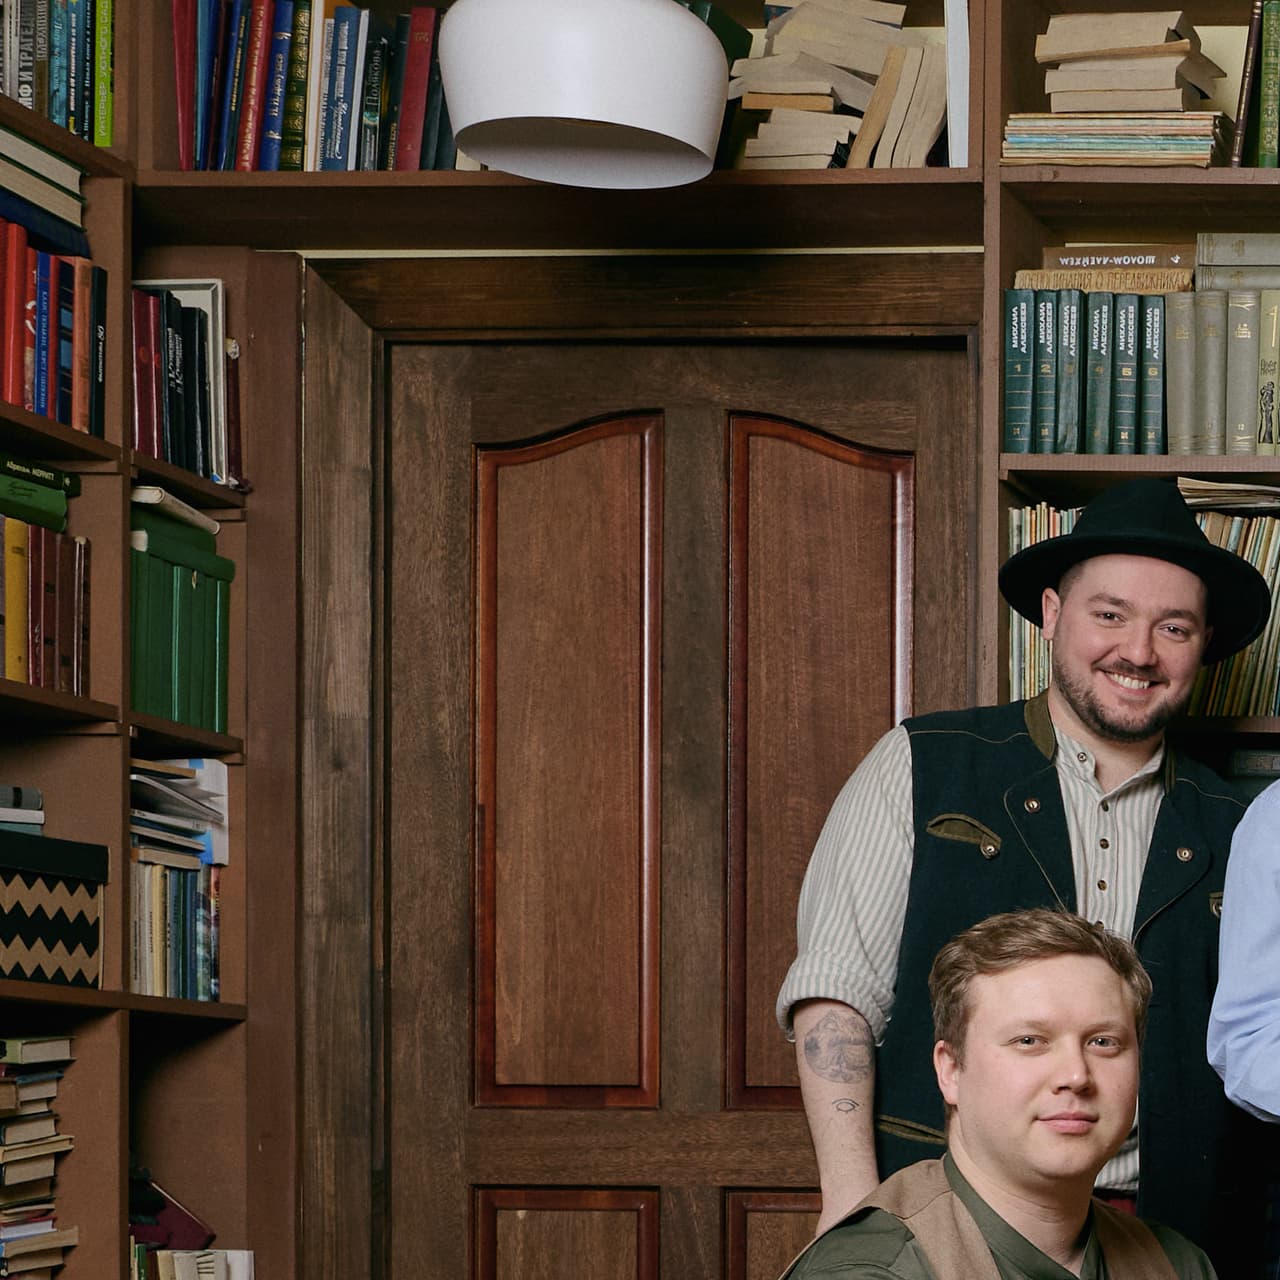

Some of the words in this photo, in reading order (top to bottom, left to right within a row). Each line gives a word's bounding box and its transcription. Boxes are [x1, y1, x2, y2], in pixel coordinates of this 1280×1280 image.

[20, 0, 34, 68] ТРАГЕДИ
[1059, 255, 1156, 267] ШОЛОМ-АЛЕЙХЕМ
[1041, 364, 1051, 373] 2
[1121, 367, 1132, 376] 5
[1148, 367, 1158, 376] 6
